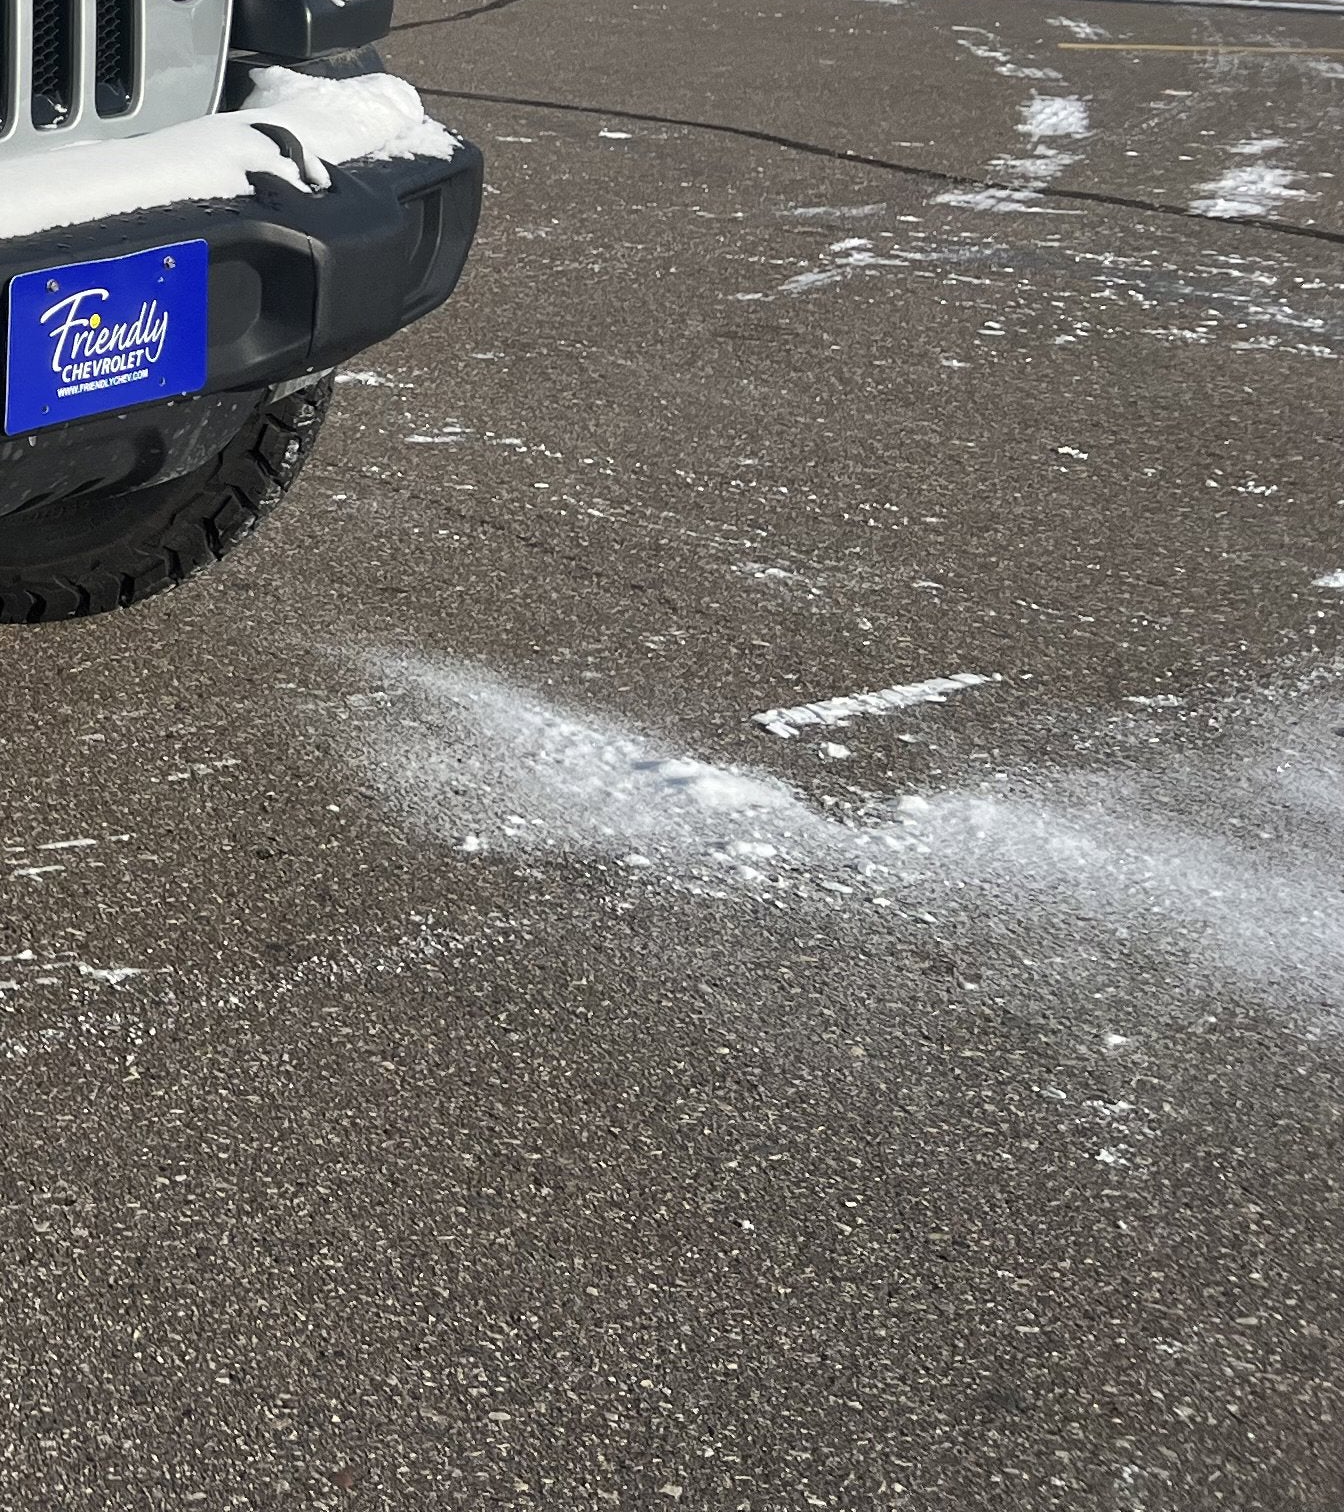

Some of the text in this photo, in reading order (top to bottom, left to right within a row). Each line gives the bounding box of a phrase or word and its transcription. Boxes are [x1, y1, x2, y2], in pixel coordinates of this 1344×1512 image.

[40, 288, 168, 372] Friendly
[62, 349, 144, 382] CHEVROLET
[57, 369, 149, 398] WWW.FRIENDLYCHEV.COM
